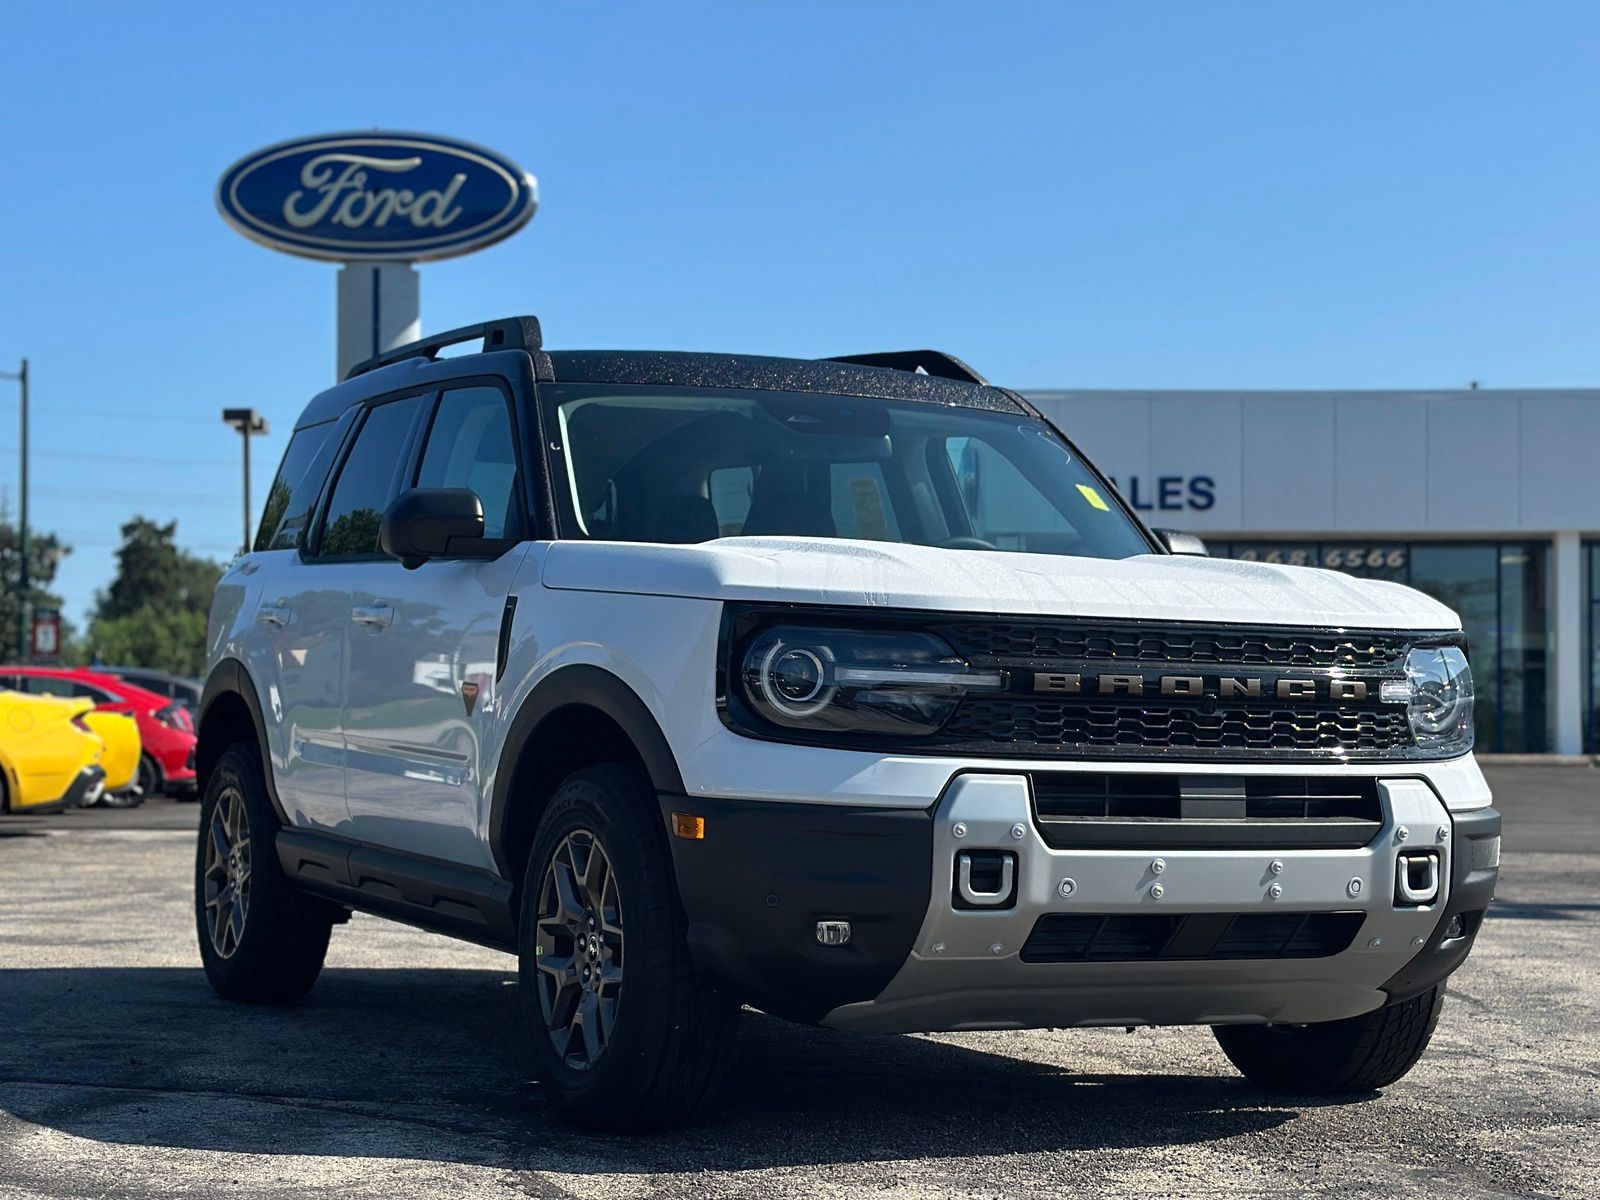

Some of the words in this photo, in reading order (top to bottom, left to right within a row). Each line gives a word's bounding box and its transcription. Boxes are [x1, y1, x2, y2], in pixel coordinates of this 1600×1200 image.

[282, 153, 467, 228] Ford
[1108, 476, 1216, 510] LES
[1033, 672, 1369, 699] BRONCO
